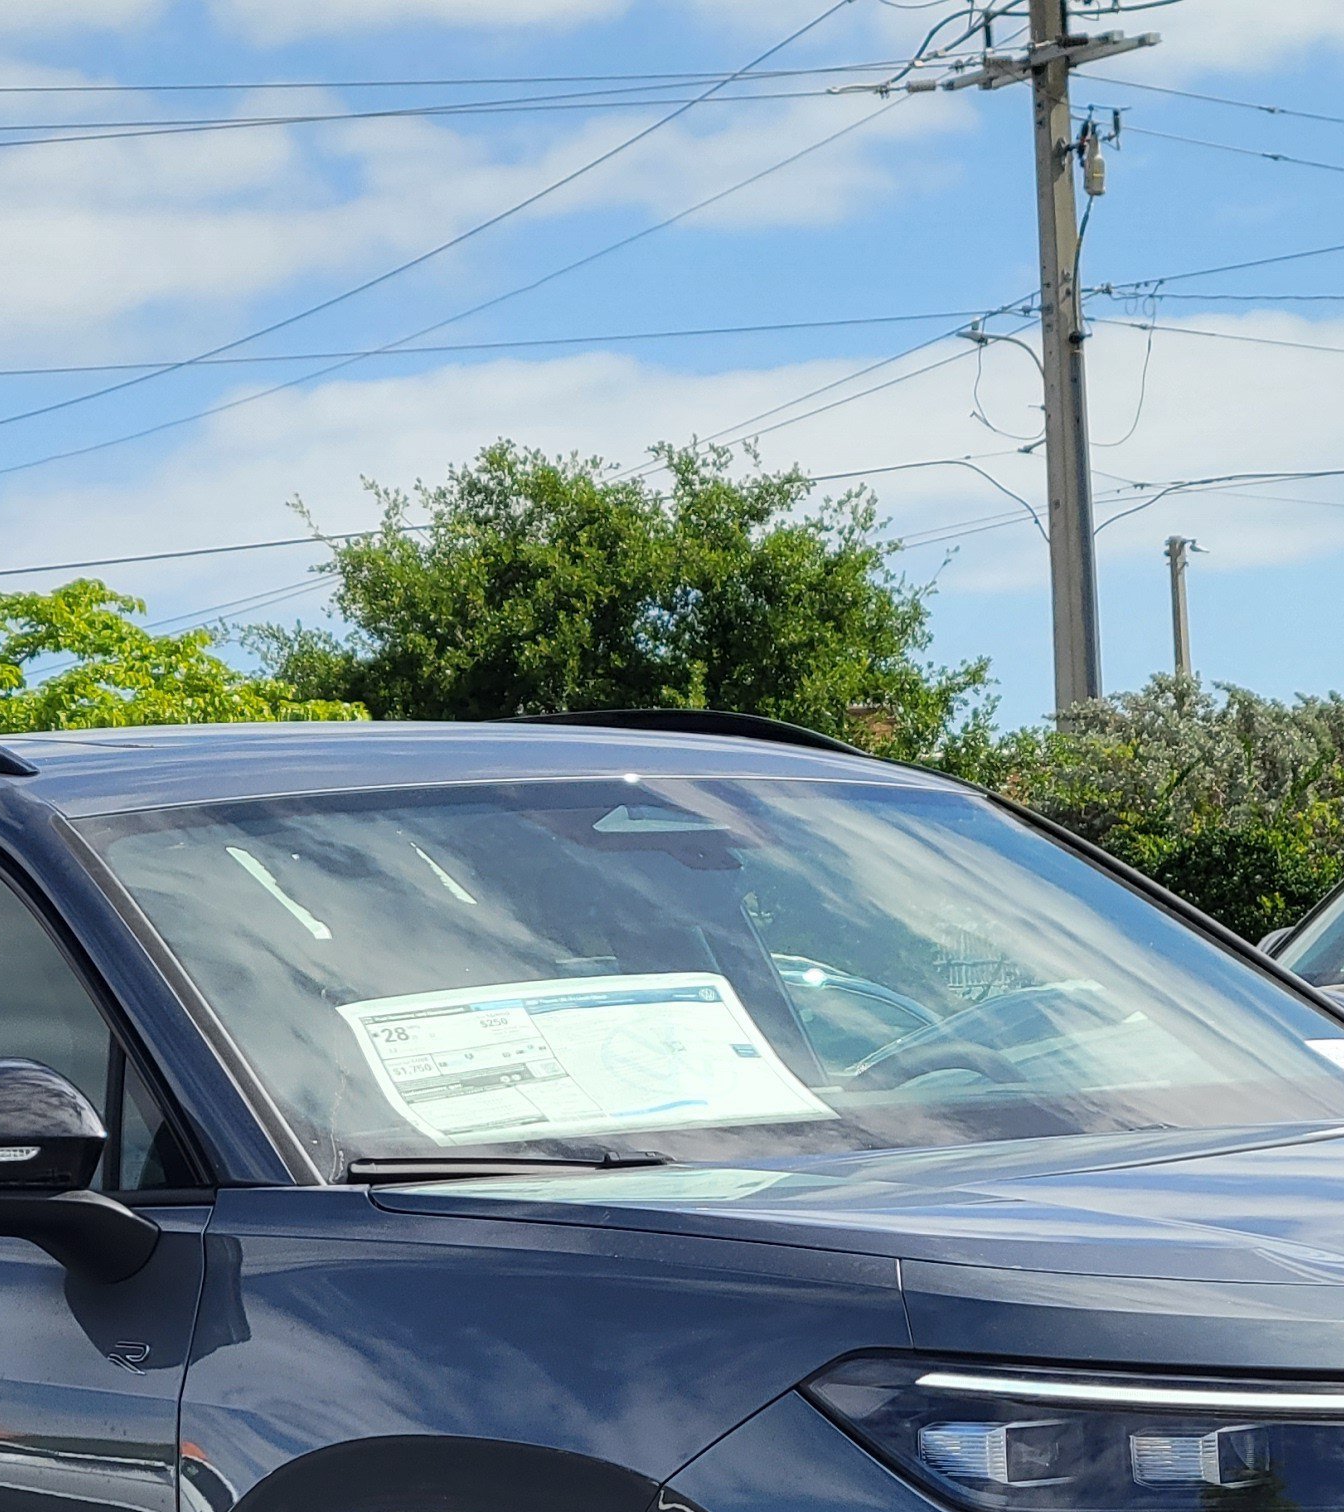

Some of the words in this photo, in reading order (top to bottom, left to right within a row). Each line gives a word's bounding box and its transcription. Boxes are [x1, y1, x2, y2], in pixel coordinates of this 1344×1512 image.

[479, 1016, 508, 1029] $250
[380, 1026, 410, 1043] 28
[392, 1063, 433, 1076] $1,750
